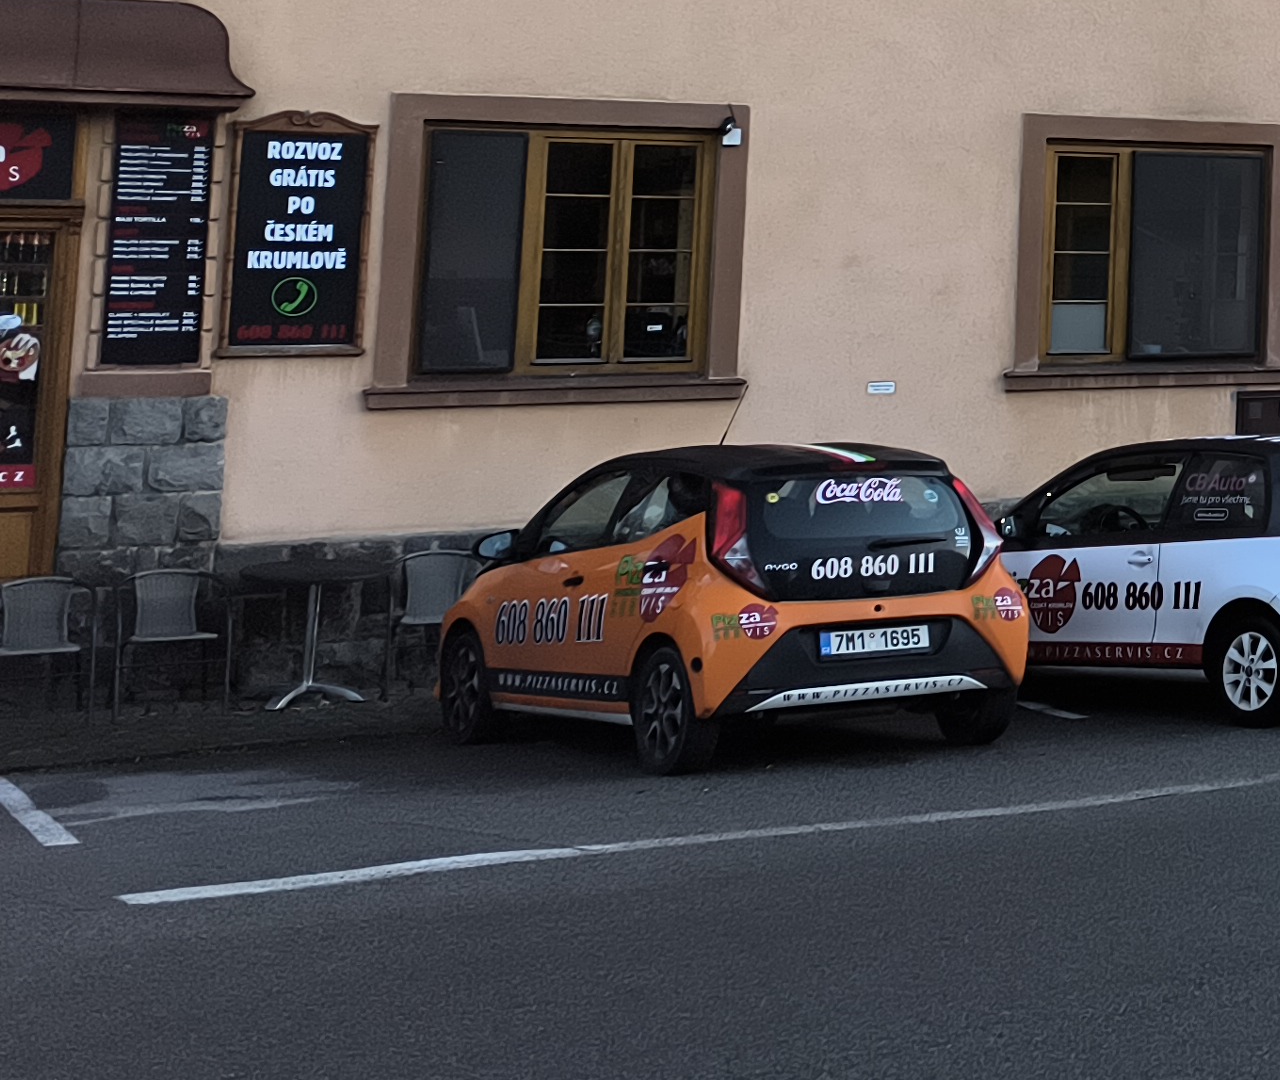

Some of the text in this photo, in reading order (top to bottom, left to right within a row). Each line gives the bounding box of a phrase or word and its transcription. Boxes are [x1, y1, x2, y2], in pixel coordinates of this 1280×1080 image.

[267, 141, 343, 161] ROZVOZ
[269, 166, 336, 188] GRÁTIS
[287, 195, 316, 215] PO
[264, 220, 334, 242] ČESKÉM
[247, 248, 347, 270] KRUMLOVĚ
[1207, 473, 1246, 491] Auto
[811, 552, 935, 580] 608 860 111
[1081, 580, 1201, 611] 608 860 111
[495, 593, 608, 645] 608 860 111
[834, 630, 865, 653] 7M1
[880, 628, 921, 649] 1695
